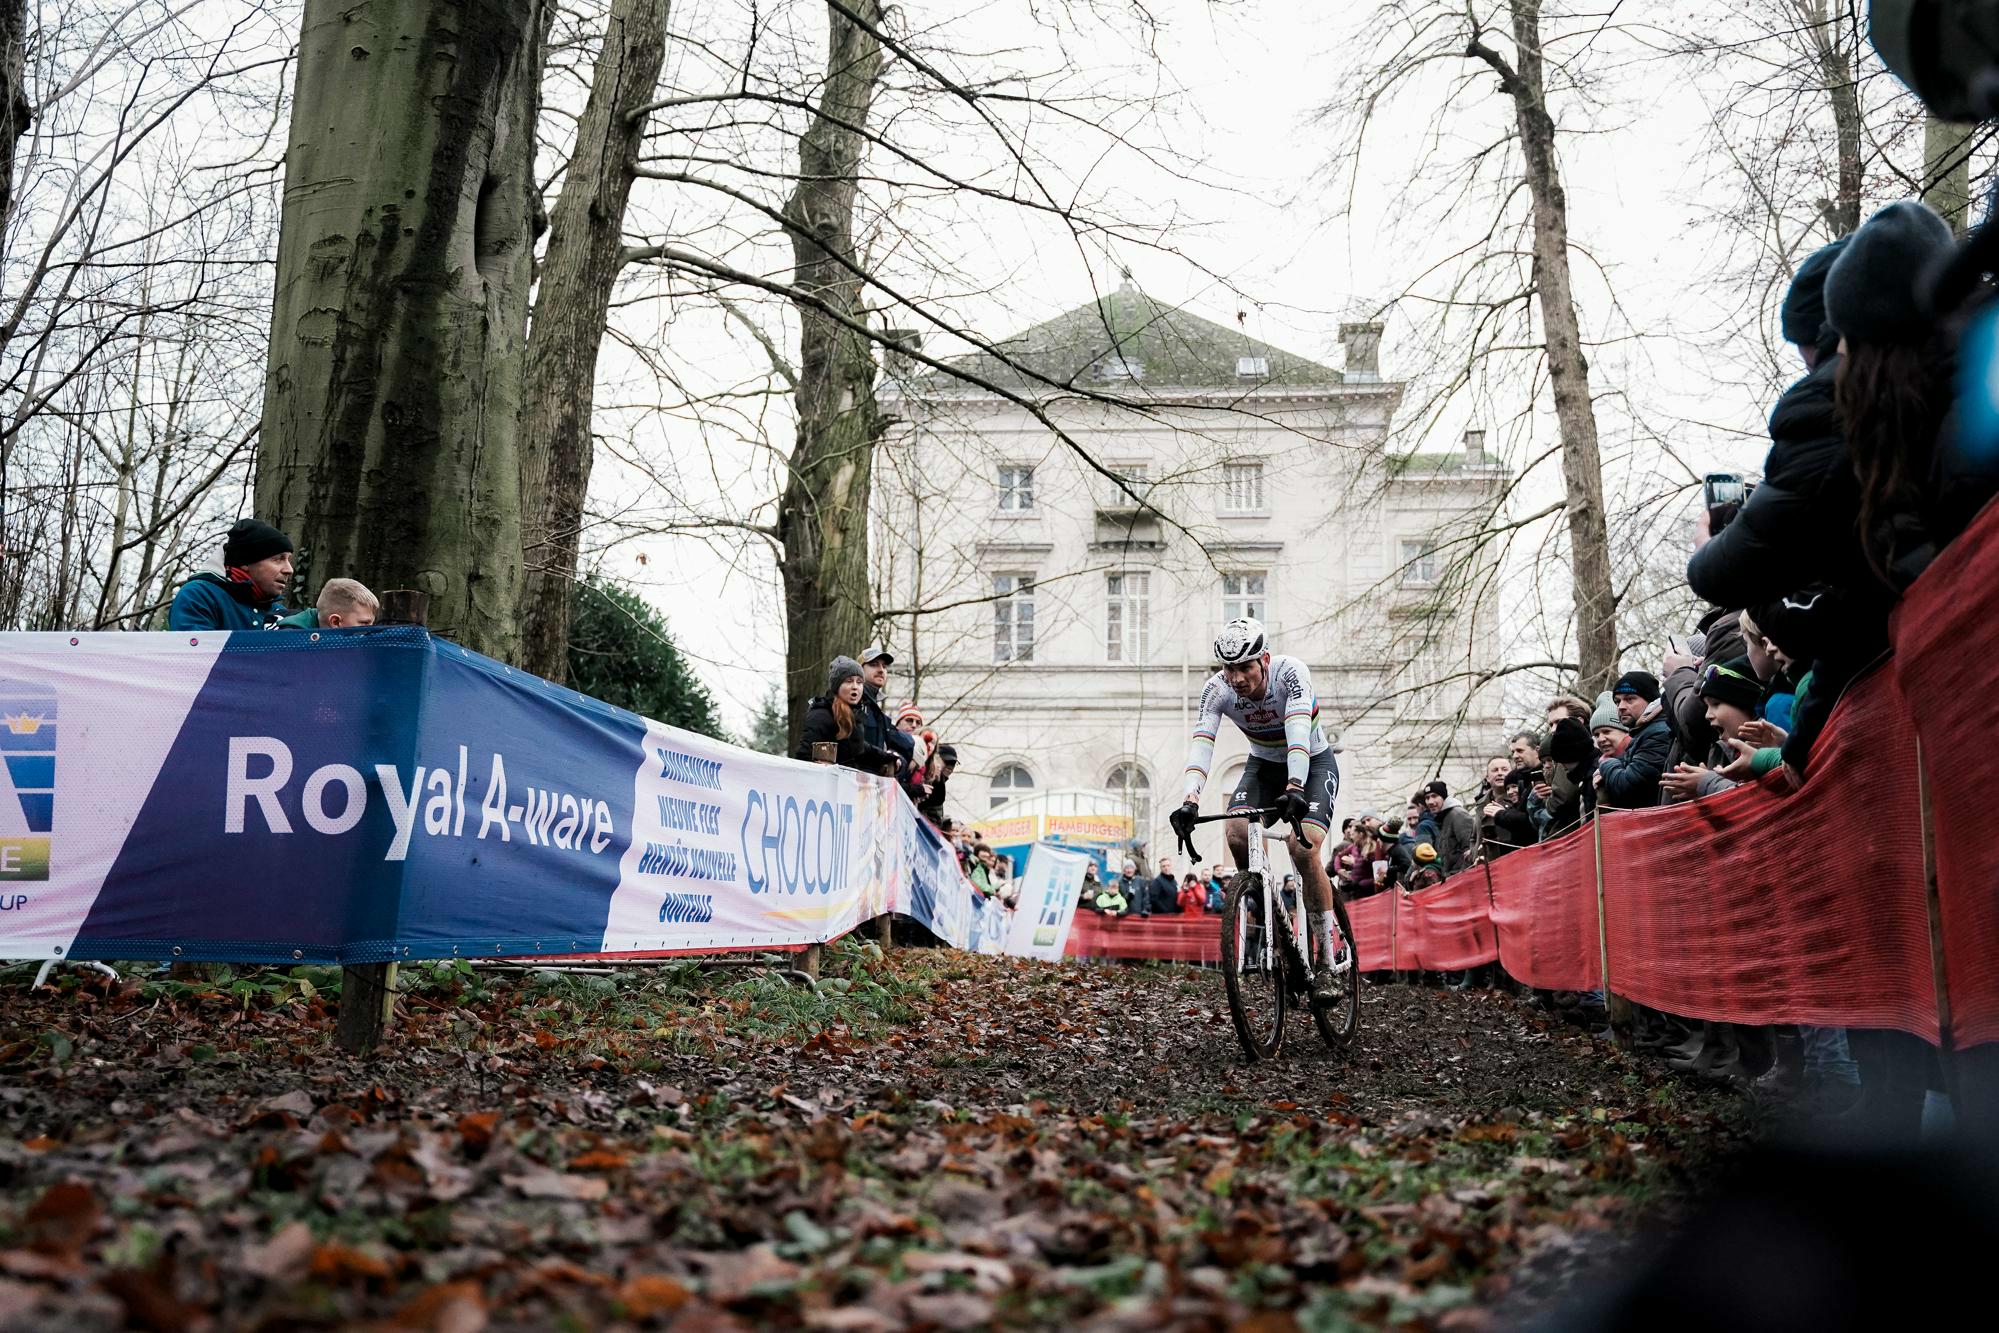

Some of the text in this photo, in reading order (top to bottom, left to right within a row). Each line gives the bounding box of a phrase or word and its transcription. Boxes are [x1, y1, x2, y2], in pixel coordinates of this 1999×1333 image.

[1282, 666, 1304, 700] Alpecin
[657, 748, 723, 791] BINNENKORT
[224, 736, 614, 861] Royal A-ware
[657, 795, 721, 836] NIEUWE FLES
[638, 838, 737, 882] BIENTÔT NOUVELLE
[741, 789, 853, 895] CHOCOVIT
[659, 892, 713, 923] BOUTEILLE
